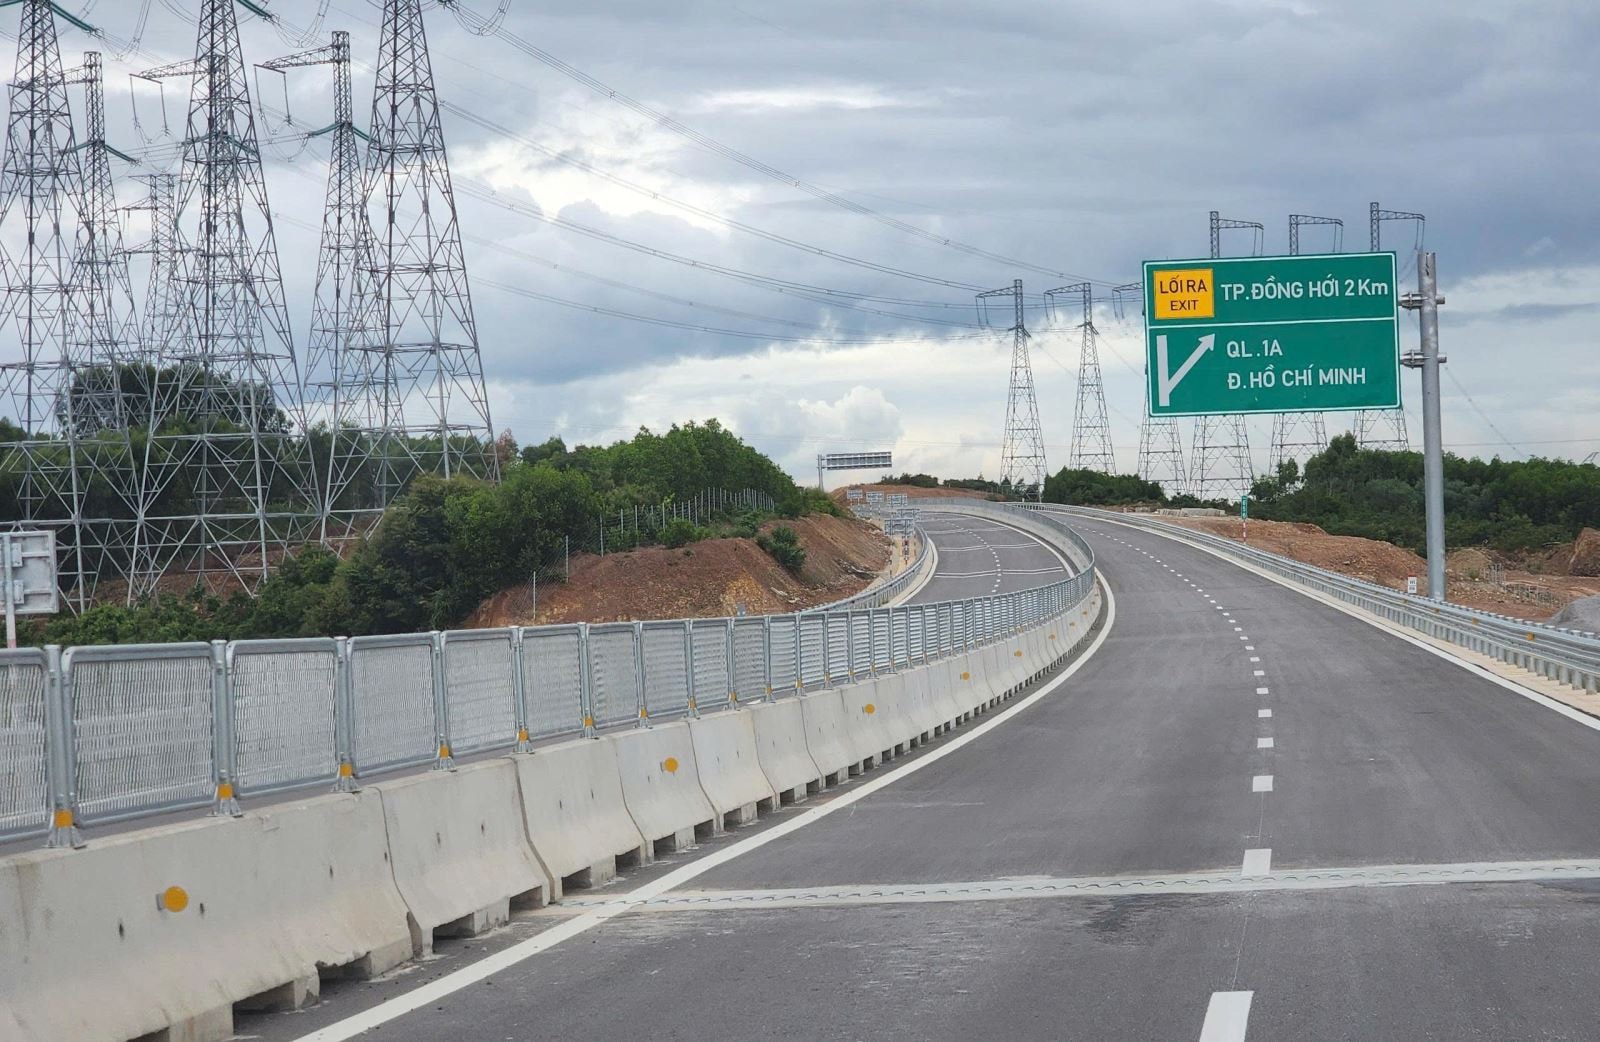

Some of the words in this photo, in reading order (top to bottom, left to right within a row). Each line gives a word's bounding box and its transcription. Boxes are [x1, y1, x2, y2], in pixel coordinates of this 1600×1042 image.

[1160, 275, 1183, 294] LỐI
[1187, 279, 1208, 293] RA
[1221, 275, 1304, 301] TP.ĐỒNG
[1308, 274, 1339, 298] HỚI
[1170, 299, 1199, 311] EXIT
[1281, 363, 1314, 387] CHÍ
[1318, 367, 1366, 386] MINH
